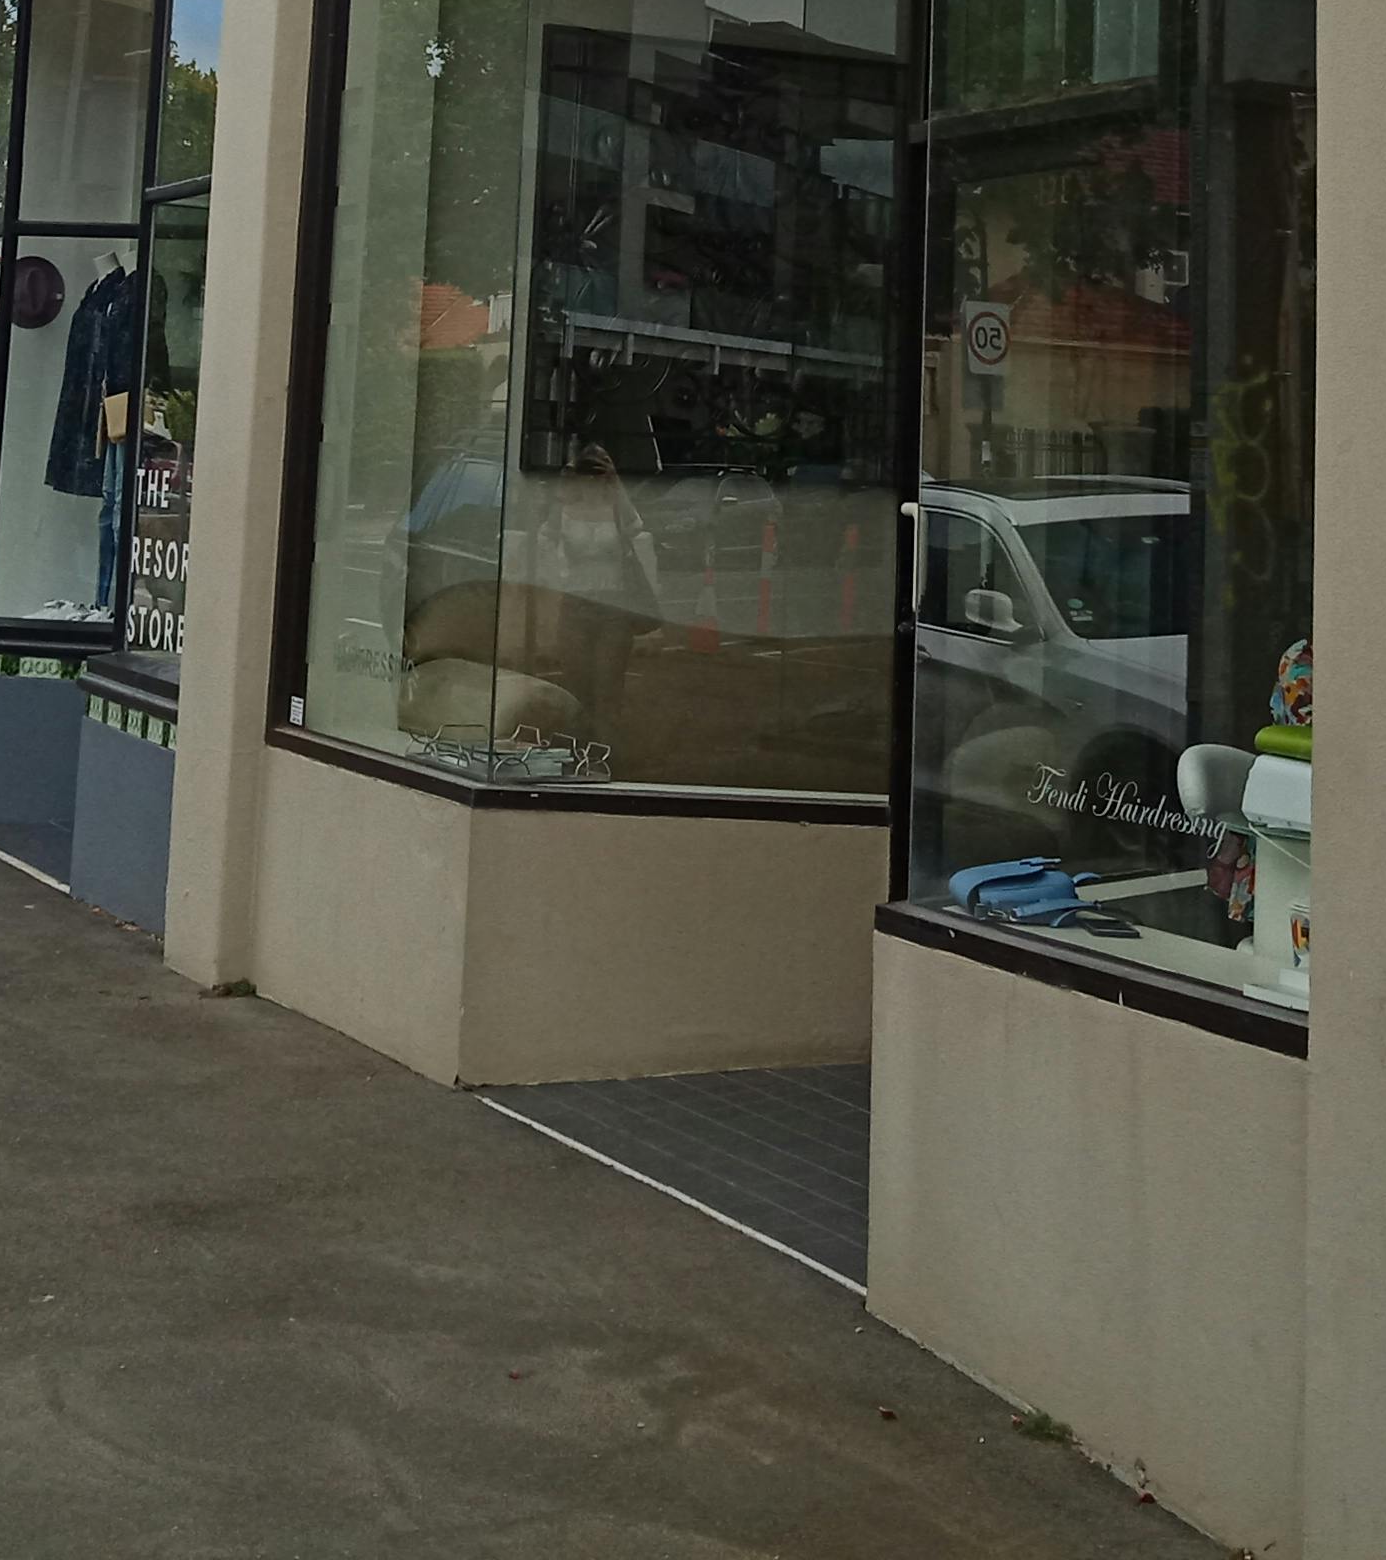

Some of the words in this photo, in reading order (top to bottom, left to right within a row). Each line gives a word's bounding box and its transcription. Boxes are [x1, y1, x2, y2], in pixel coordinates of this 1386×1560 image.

[136, 468, 171, 509] THE
[126, 604, 184, 654] STORE
[1027, 761, 1088, 813] Fendi
[1092, 772, 1227, 859] Hairdressing
